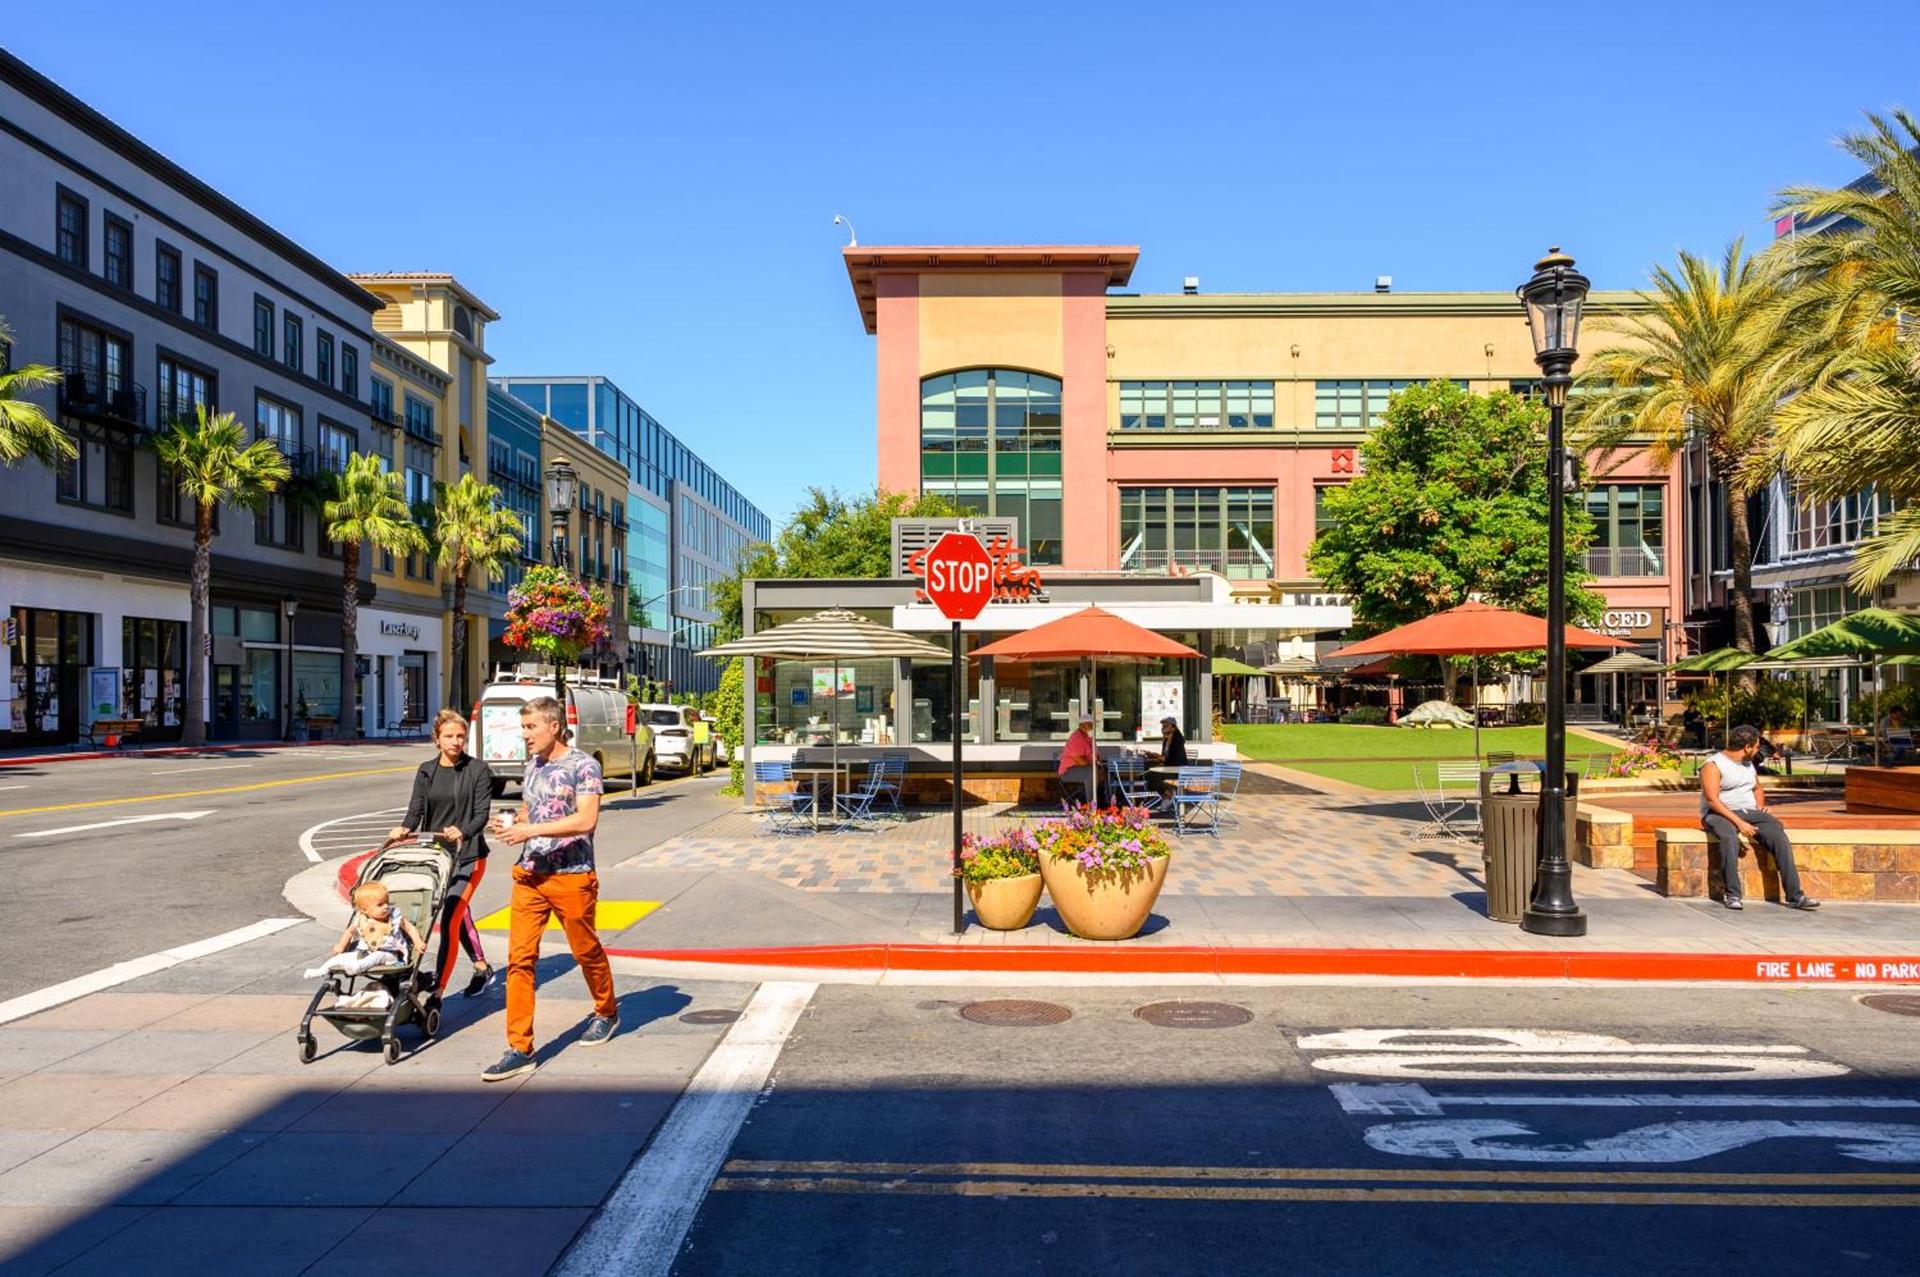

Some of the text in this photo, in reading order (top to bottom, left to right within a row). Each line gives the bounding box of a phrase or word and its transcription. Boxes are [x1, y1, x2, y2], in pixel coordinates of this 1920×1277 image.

[931, 559, 989, 593] STOP
[1757, 962, 1791, 977] FIRE
[1797, 962, 1836, 977] LANE
[1855, 963, 1877, 978] NO
[1882, 963, 1919, 978] PARK
